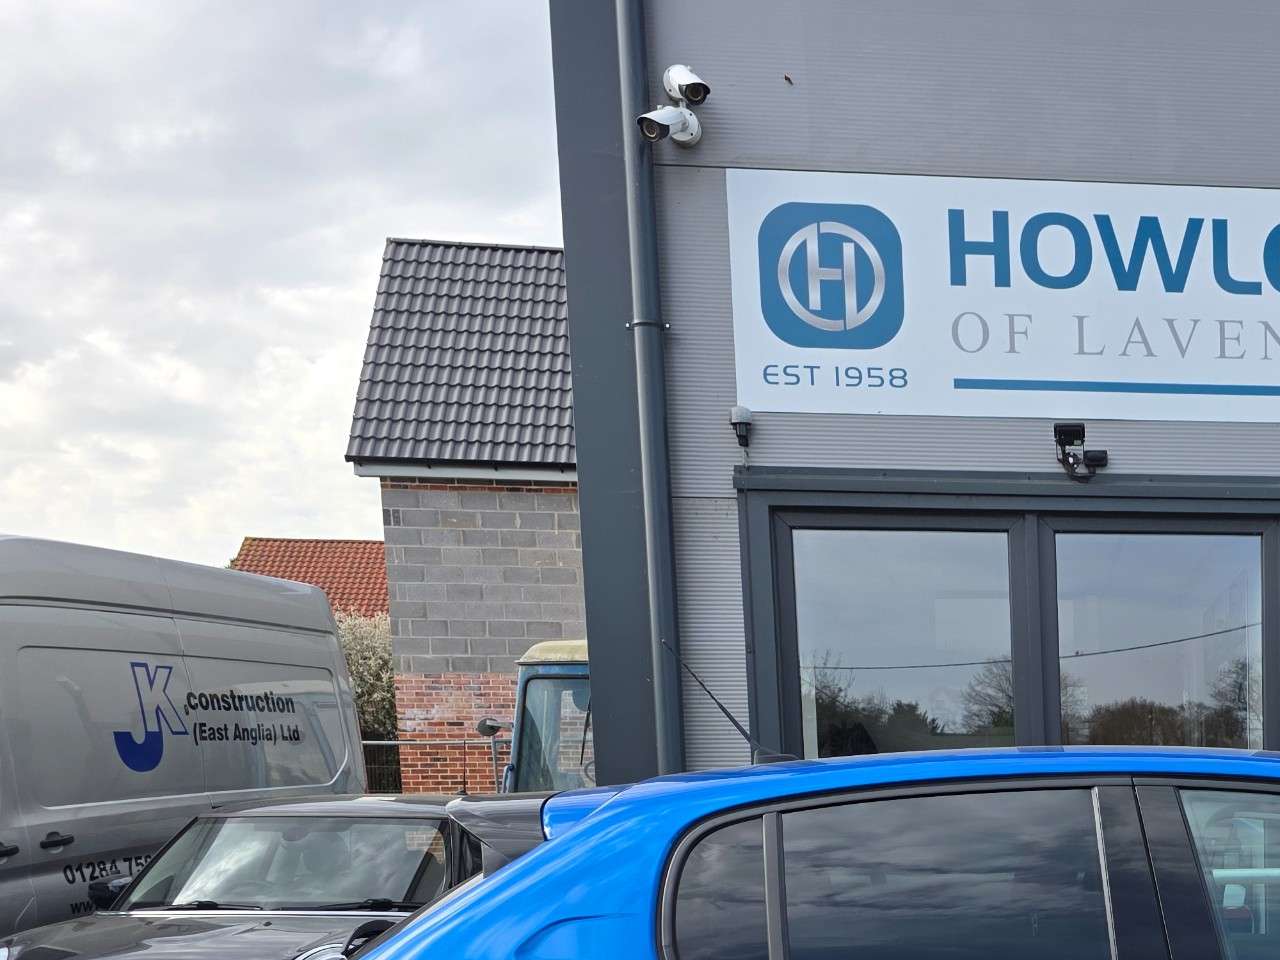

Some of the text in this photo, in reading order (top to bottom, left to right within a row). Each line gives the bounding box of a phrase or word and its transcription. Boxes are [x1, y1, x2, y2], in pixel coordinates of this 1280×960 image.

[951, 311, 1032, 354] OF
[763, 365, 908, 389] EST 1958
[185, 690, 296, 714] construction
[193, 723, 301, 746] (East Anglia) Ltd
